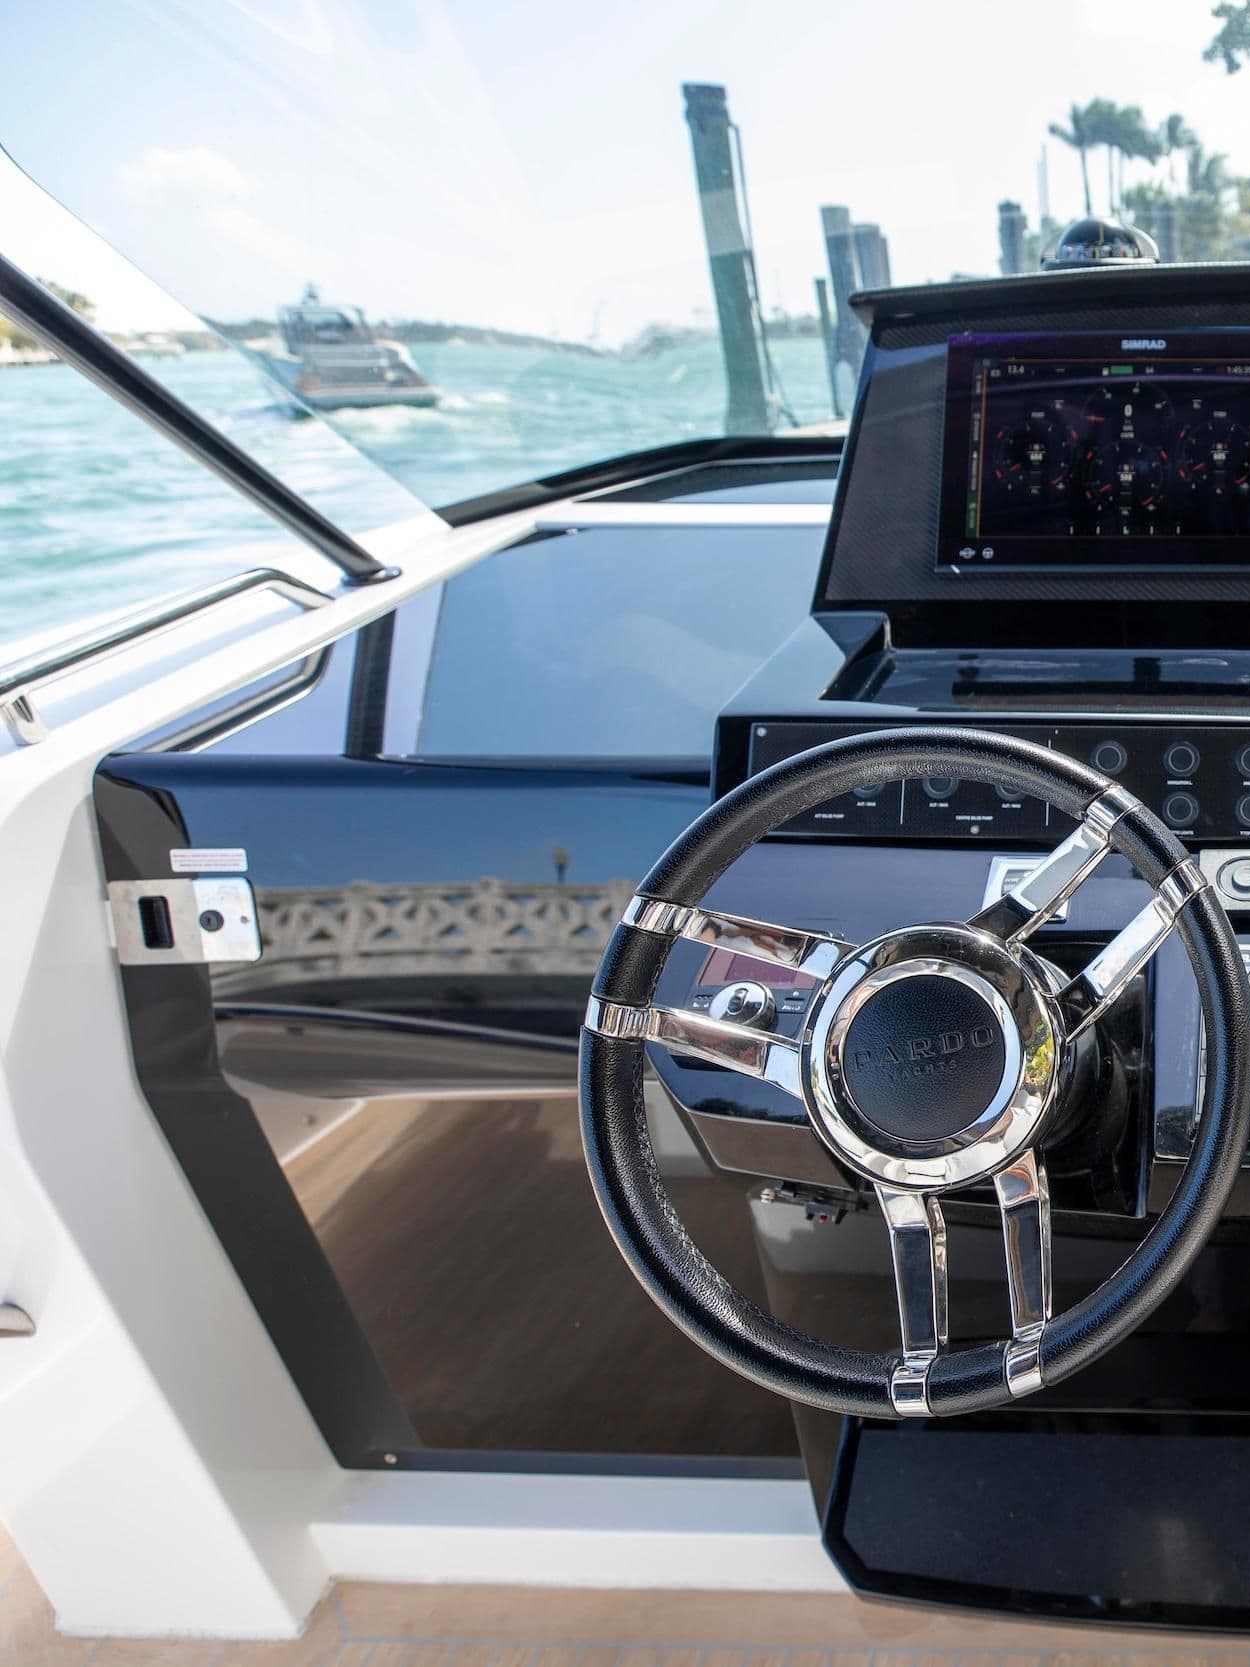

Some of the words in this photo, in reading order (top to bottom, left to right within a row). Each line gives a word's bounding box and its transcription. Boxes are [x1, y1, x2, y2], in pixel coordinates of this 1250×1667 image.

[1121, 340, 1167, 350] SIMRAD
[1124, 404, 1133, 417] 0
[853, 1026, 993, 1072] PARDO
